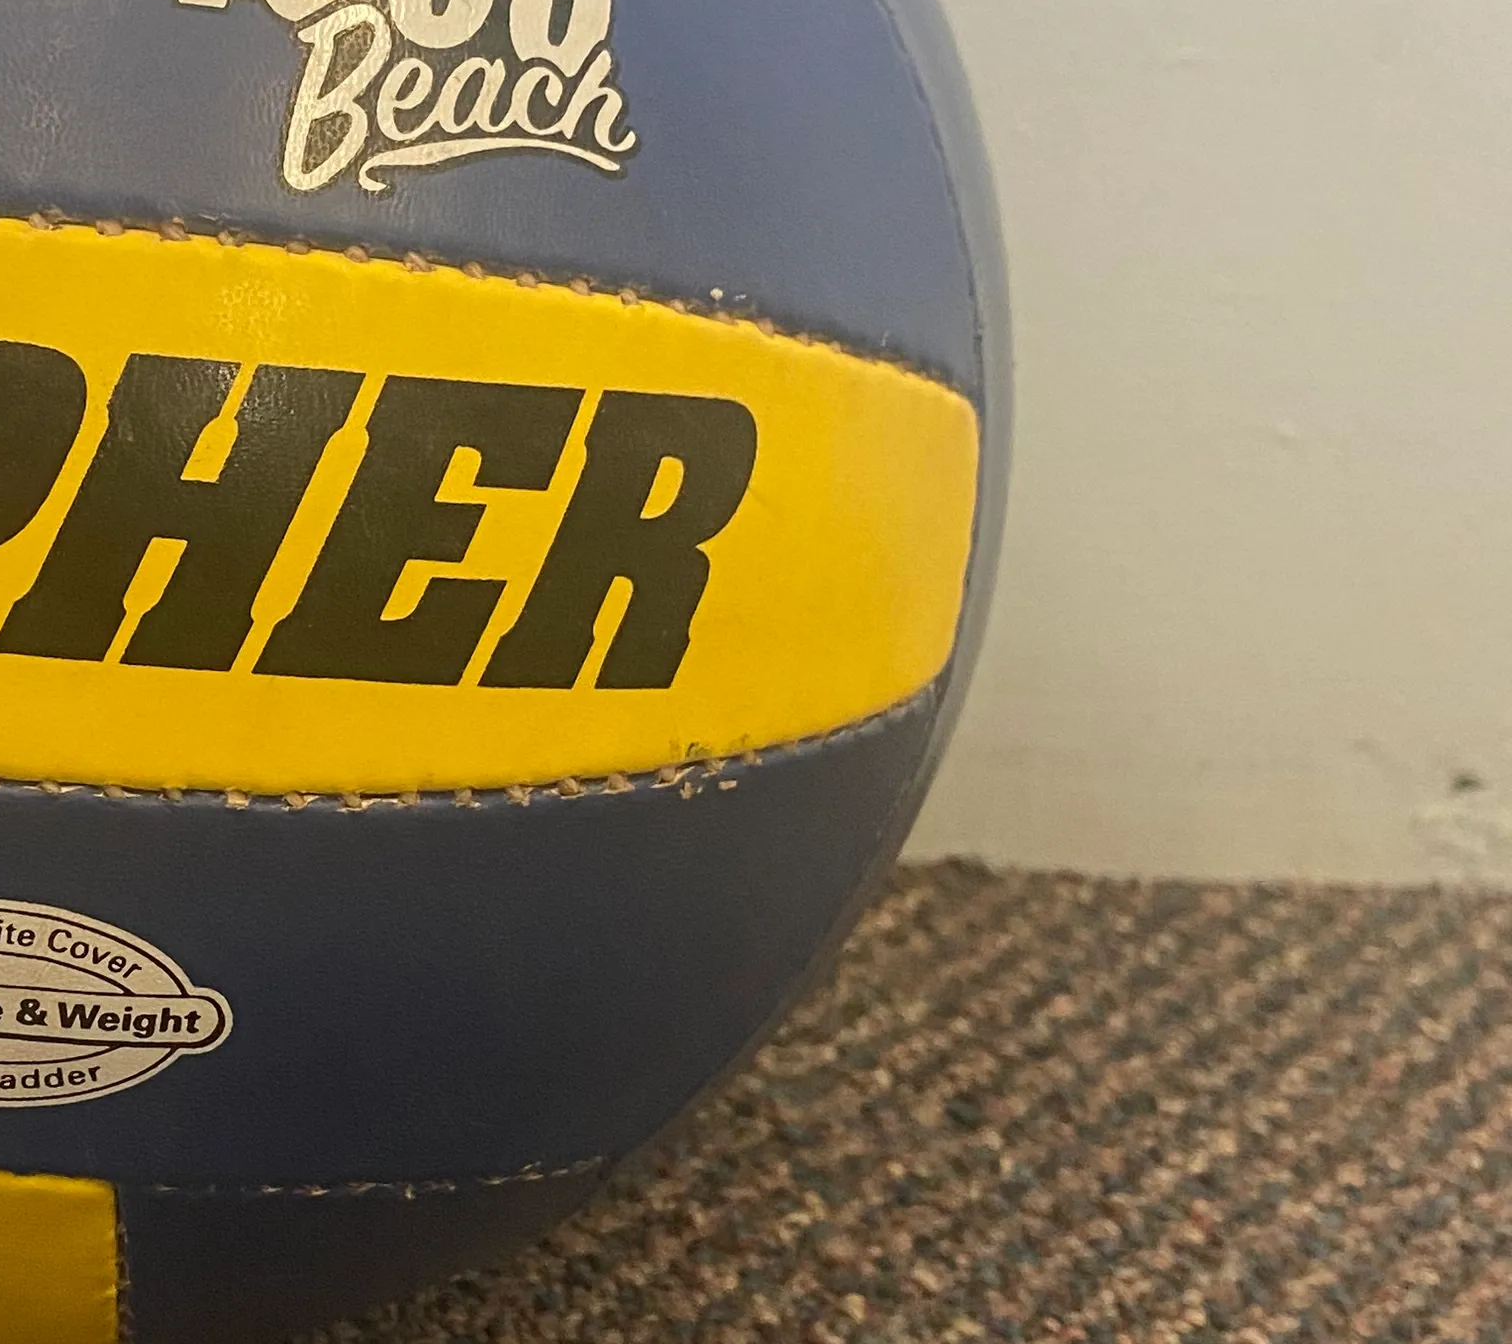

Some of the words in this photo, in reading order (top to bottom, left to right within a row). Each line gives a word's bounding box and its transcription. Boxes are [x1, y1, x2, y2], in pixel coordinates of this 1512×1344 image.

[284, 0, 637, 191] Beach
[47, 929, 142, 978] Cover
[16, 998, 48, 1026] &
[58, 1001, 202, 1038] Weight
